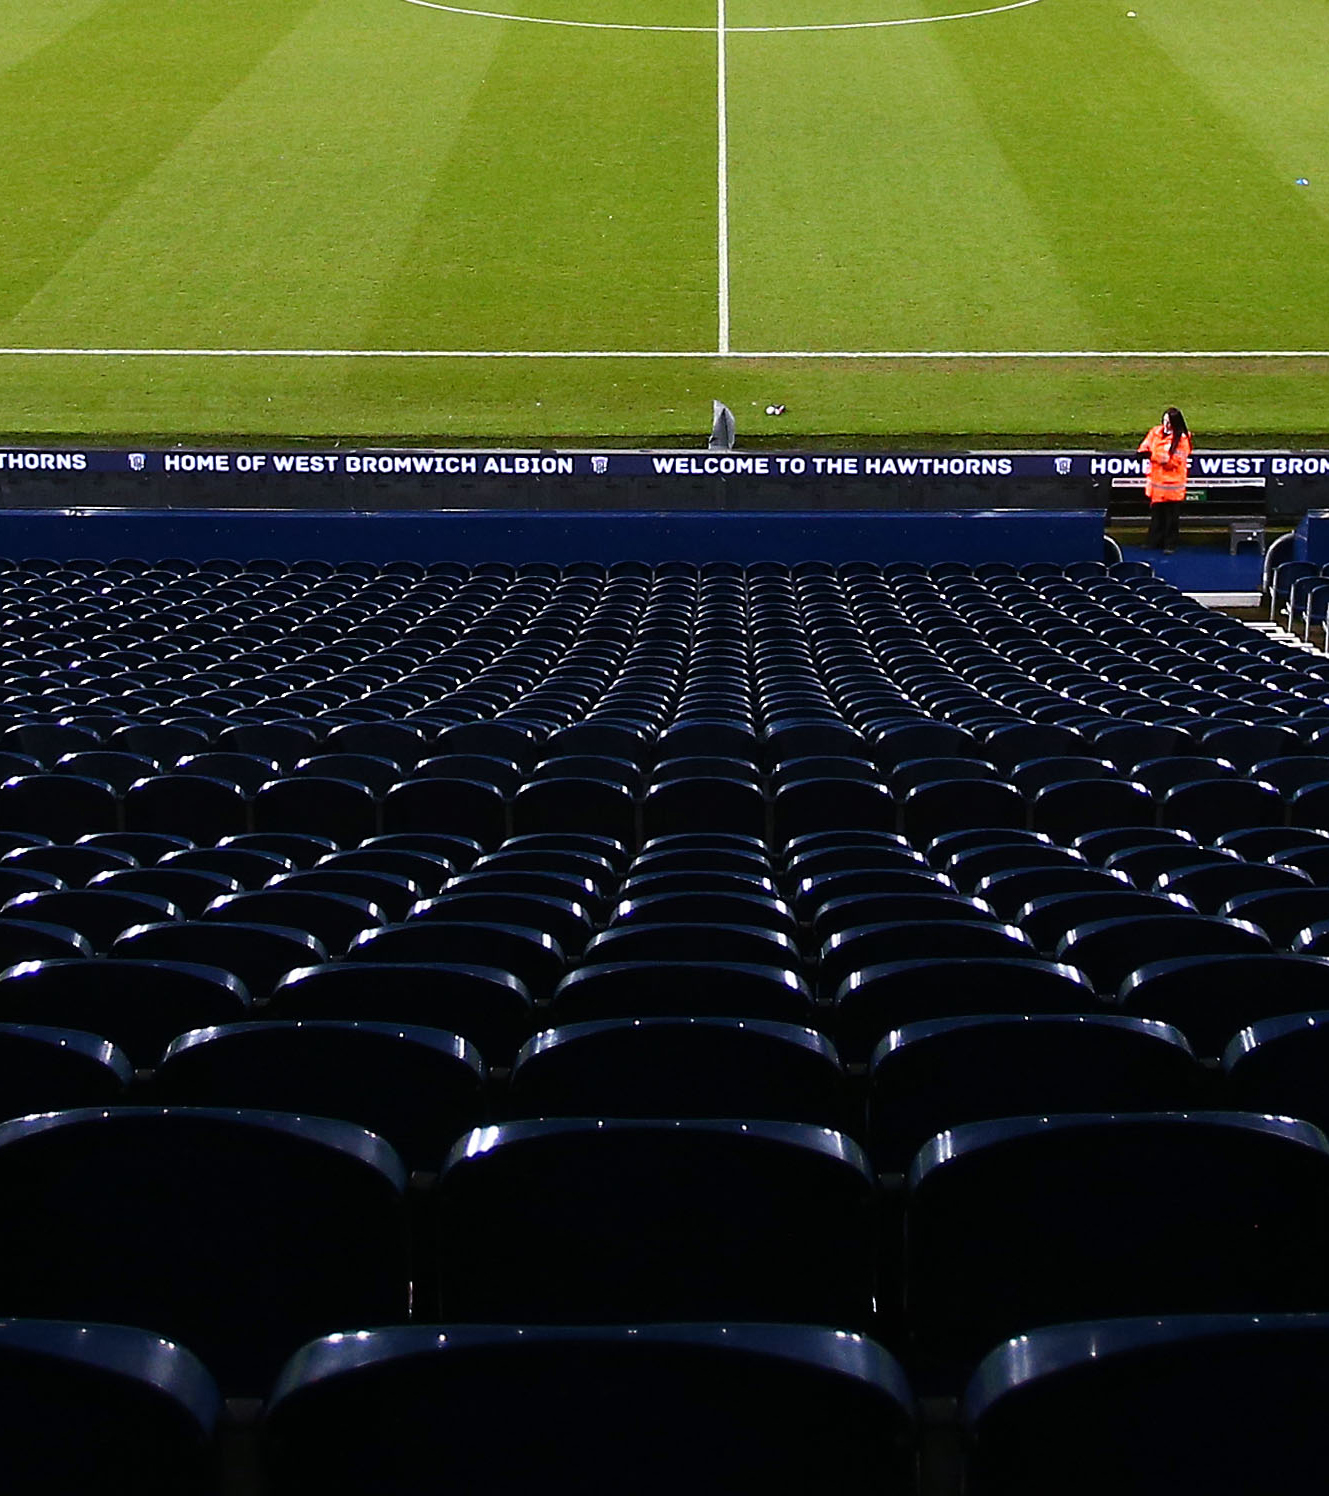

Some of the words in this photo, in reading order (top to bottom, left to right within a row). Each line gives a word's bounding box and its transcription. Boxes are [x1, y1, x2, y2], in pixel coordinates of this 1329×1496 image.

[165, 455, 229, 471] HOME
[237, 456, 265, 471] OF
[273, 456, 338, 471] WEST
[346, 457, 476, 472] BROMWICH
[484, 458, 572, 473] ALBION
[653, 458, 769, 473] WELCOME
[776, 458, 805, 473] TO
[813, 458, 857, 473] THE
[866, 459, 1011, 474] HAWTHORNS
[1200, 458, 1264, 473] WEST
